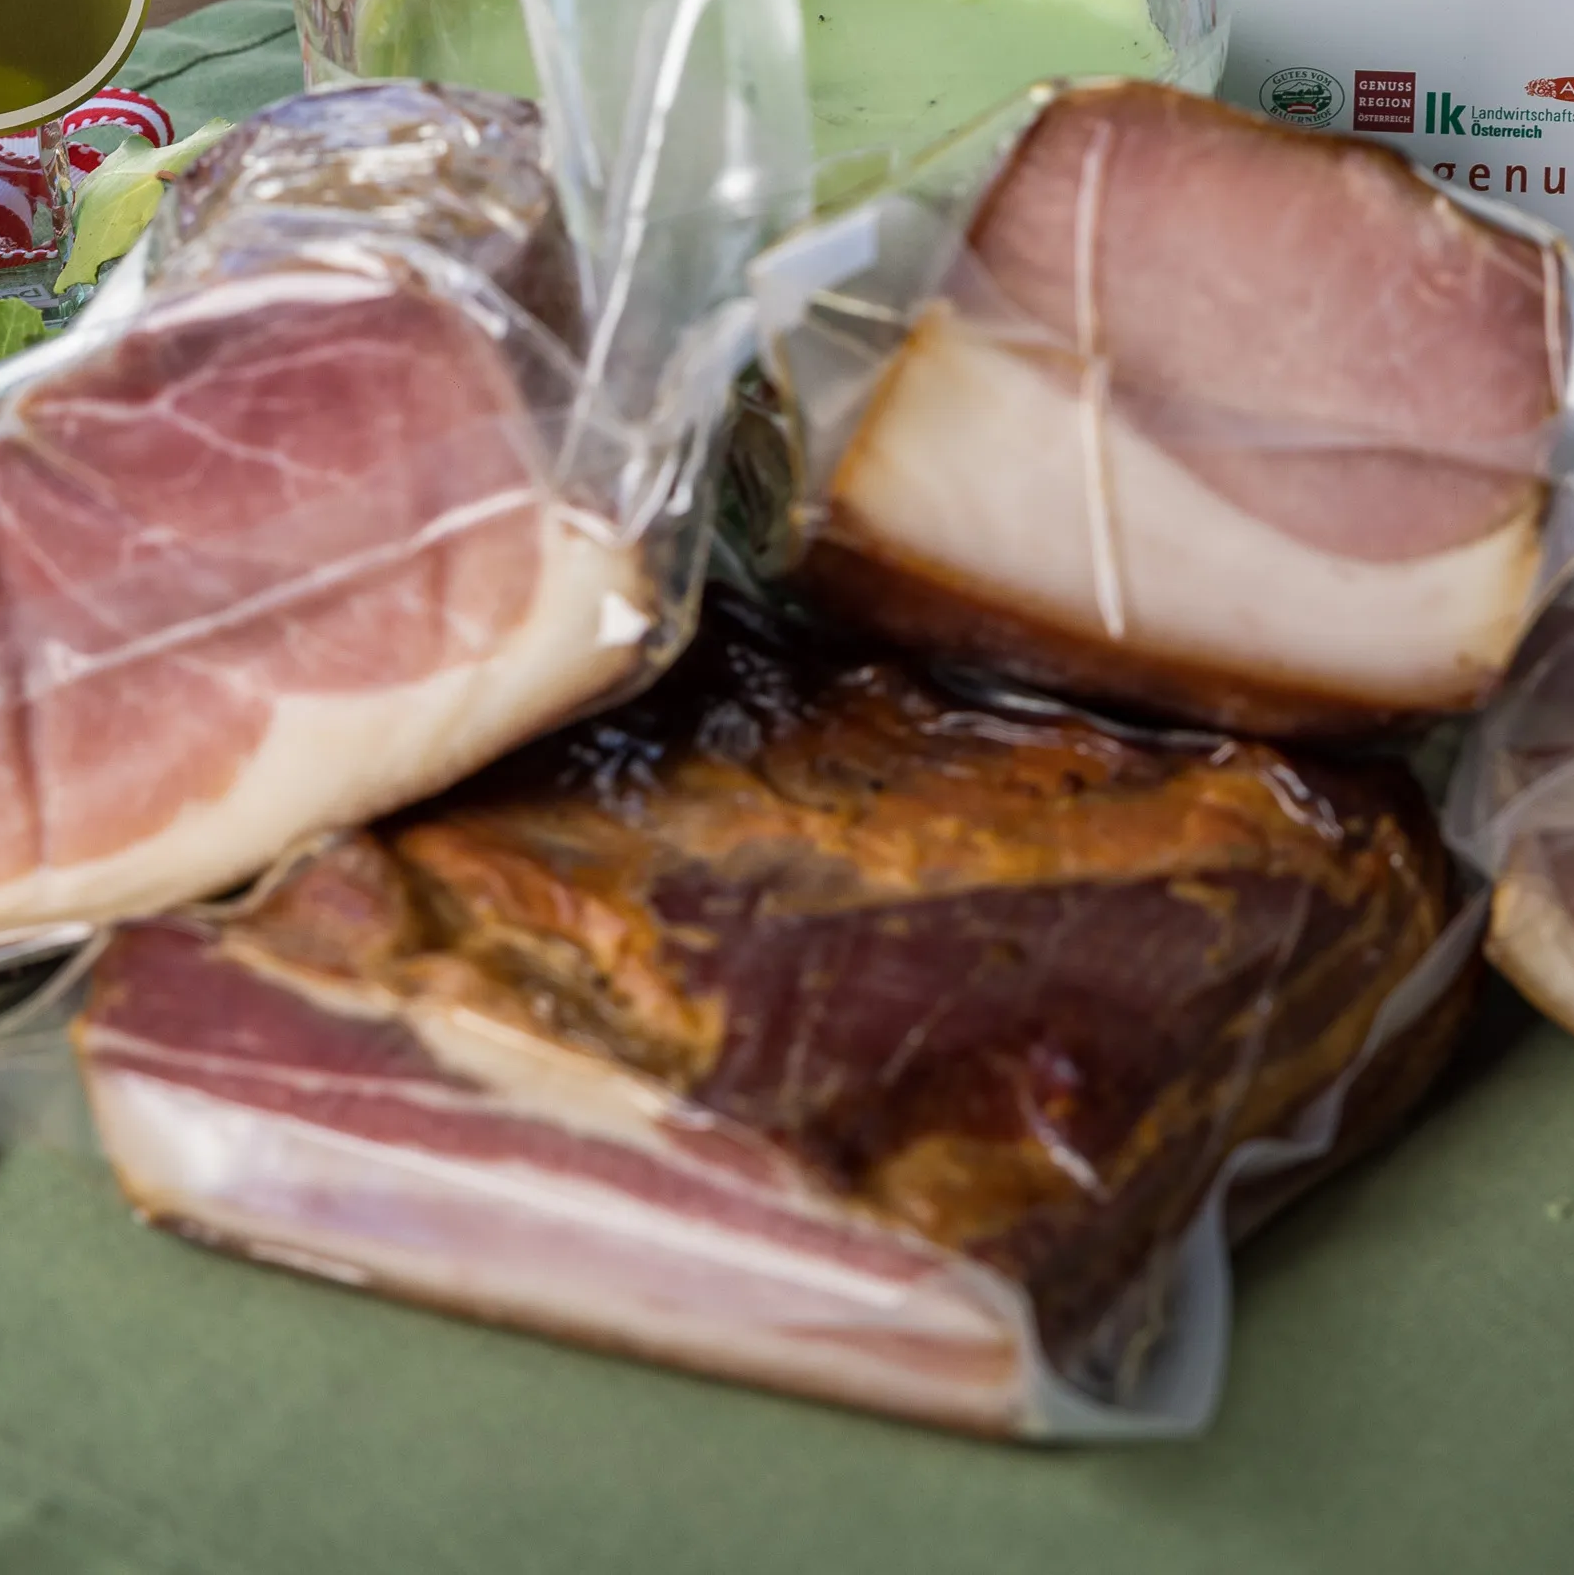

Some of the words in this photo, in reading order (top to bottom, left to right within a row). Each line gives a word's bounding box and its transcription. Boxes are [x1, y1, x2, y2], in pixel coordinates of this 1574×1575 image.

[1272, 70, 1308, 86] GUTES
[1309, 71, 1333, 87] VOM
[1359, 80, 1413, 92] GENUSS
[1358, 96, 1412, 109] REGION
[1269, 105, 1333, 125] BAUERNHOF
[1357, 111, 1411, 124] ÖSTERREICH
[1470, 119, 1543, 139] Österreich
